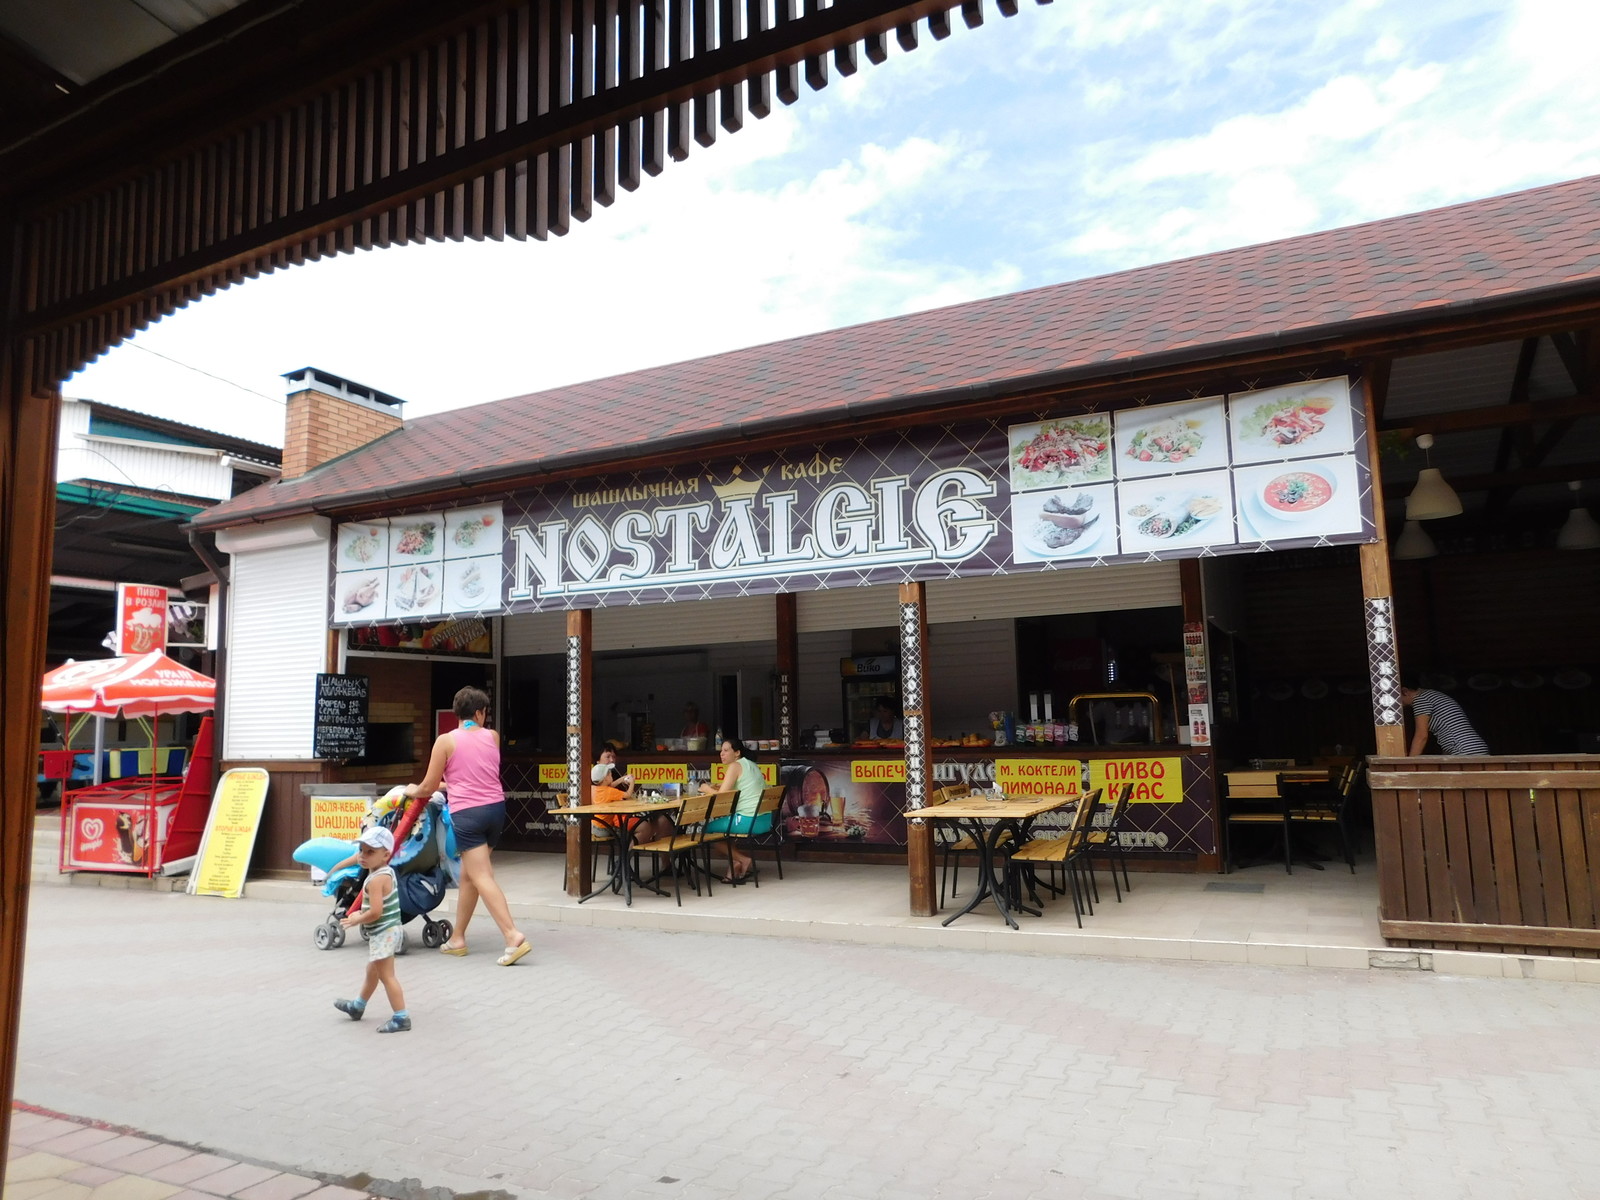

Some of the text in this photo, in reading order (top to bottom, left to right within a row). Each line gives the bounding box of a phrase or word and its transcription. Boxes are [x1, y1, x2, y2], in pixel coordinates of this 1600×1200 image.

[508, 467, 999, 601] NOSTALGIE
[137, 587, 160, 598] ПИВО
[1372, 599, 1389, 644] ЧАЙ
[1379, 661, 1395, 722] КОФЕ
[780, 675, 790, 746] ПИРОЖКИ
[542, 768, 567, 779] ЧЕБУ
[631, 767, 684, 780] ШАУРМА
[854, 763, 905, 779] ВЫПЕЧ
[1001, 765, 1014, 777] М.
[1018, 764, 1077, 777] КОКТЕЛИ
[1104, 760, 1166, 781] ПИВО
[314, 802, 365, 813] ЛЮЛЯ-КЕБАБ
